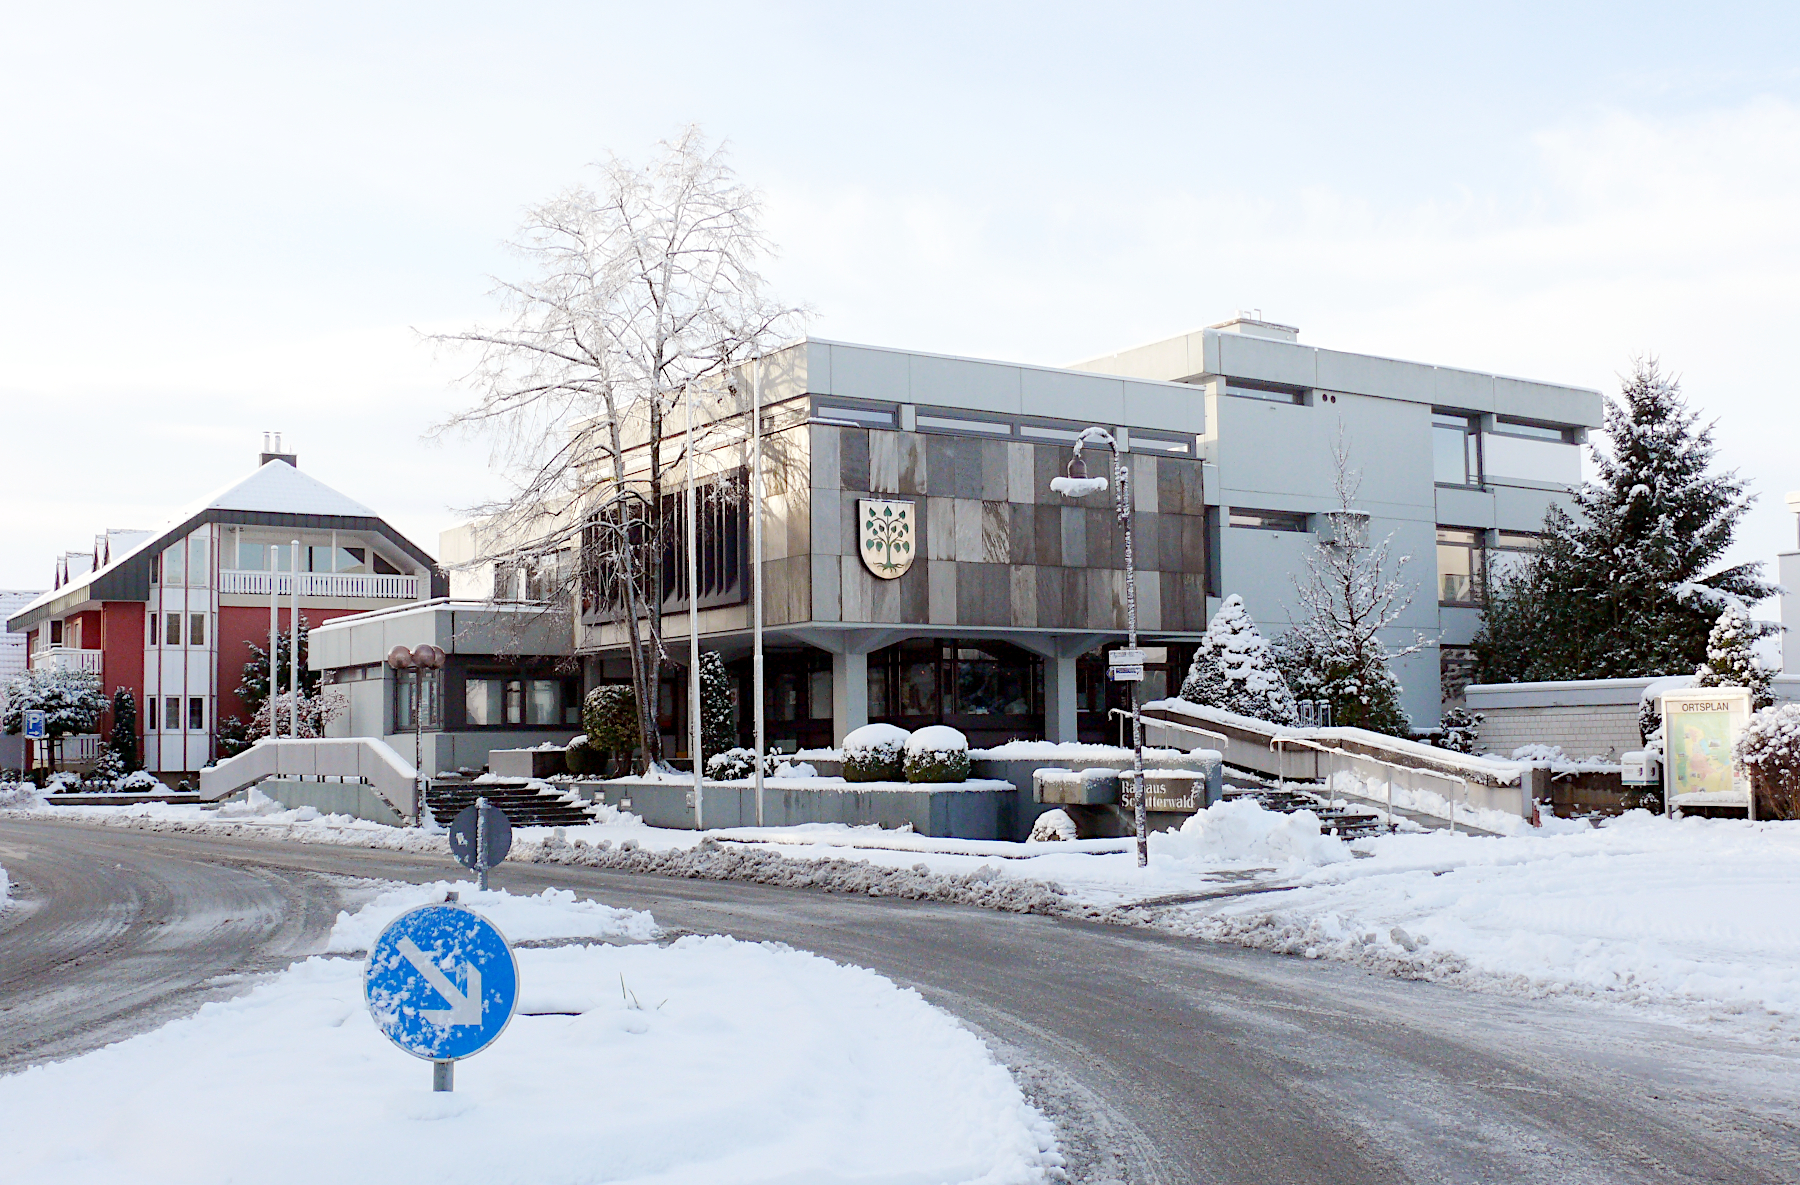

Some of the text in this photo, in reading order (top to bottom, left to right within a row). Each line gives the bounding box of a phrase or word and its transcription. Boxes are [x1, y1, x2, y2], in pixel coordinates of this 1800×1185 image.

[1682, 702, 1729, 712] ORTSPLAN
[29, 713, 40, 730] P
[1121, 780, 1167, 794] Raaus
[1121, 793, 1194, 809] Sctterwald
